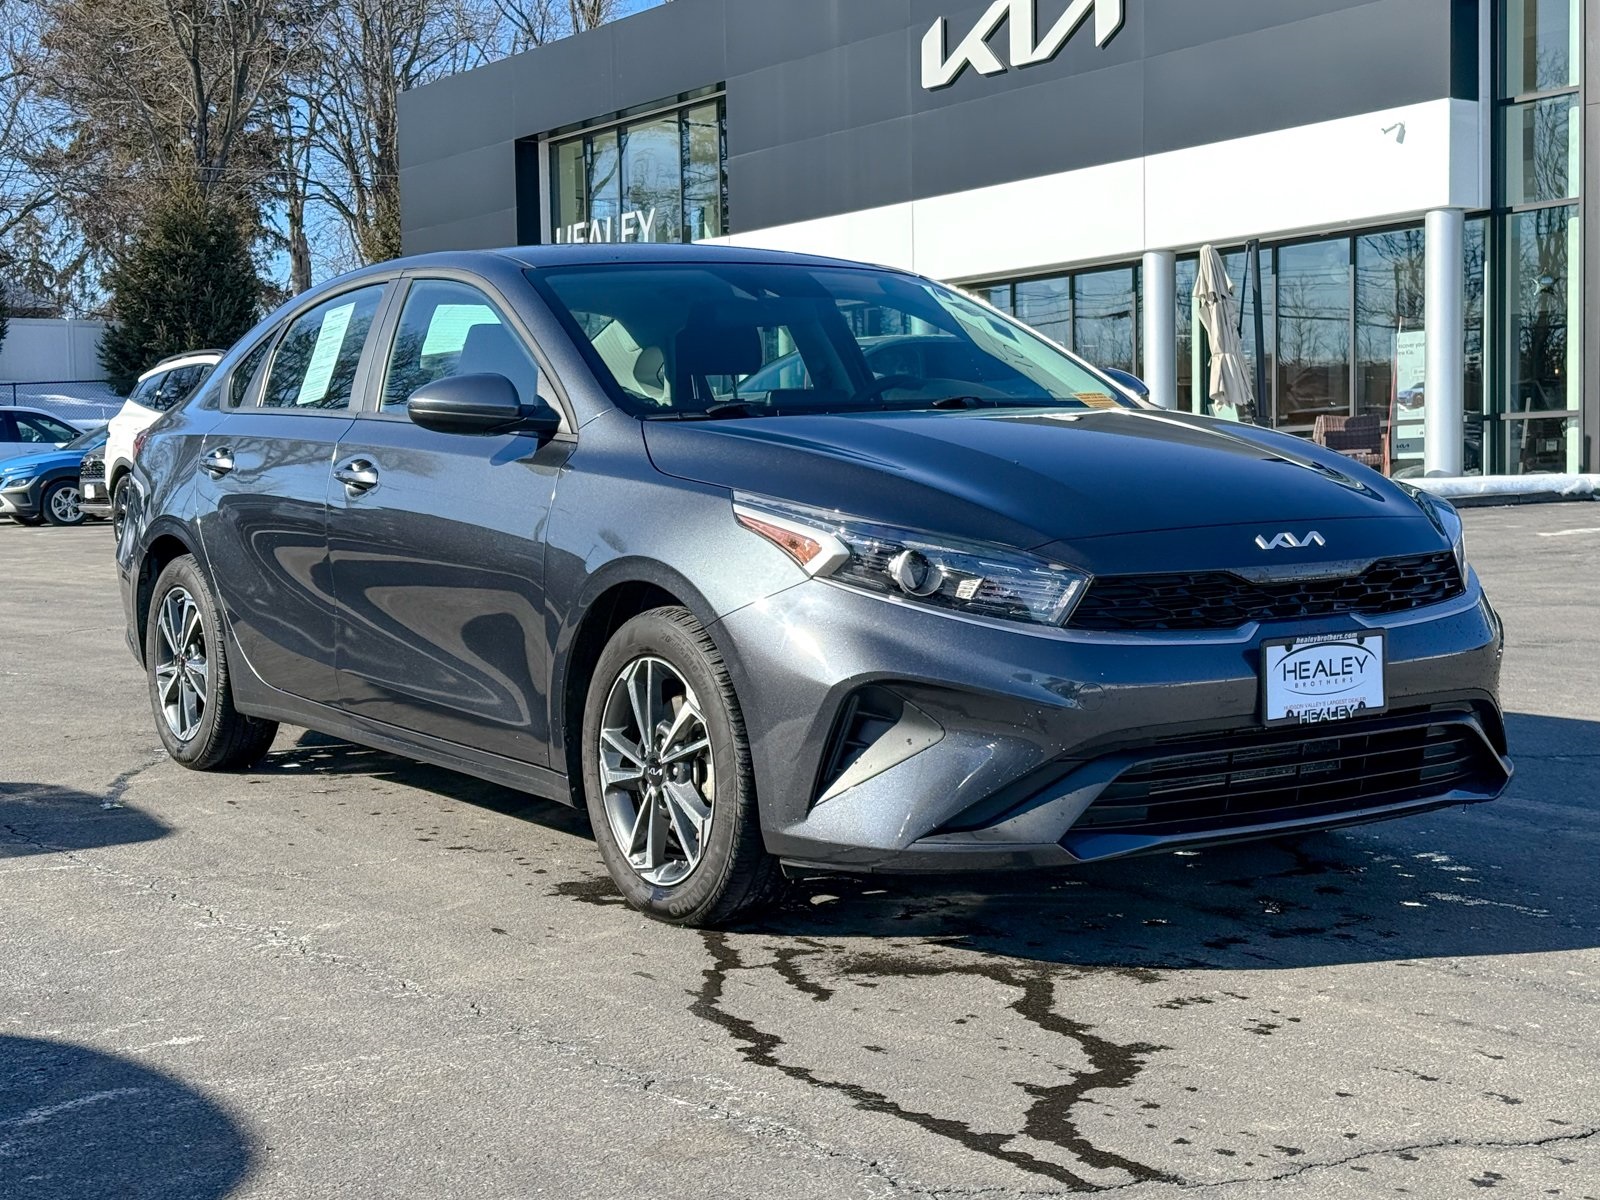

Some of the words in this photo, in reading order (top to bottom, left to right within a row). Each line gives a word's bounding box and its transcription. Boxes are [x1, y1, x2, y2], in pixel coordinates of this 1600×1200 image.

[921, 0, 1121, 90] KIA
[1254, 530, 1326, 550] KIA
[1296, 633, 1357, 644] healeybrothers.com
[1283, 655, 1368, 681] HEALEY
[1295, 678, 1353, 688] BROTHERS
[1299, 704, 1355, 725] HEALEY
